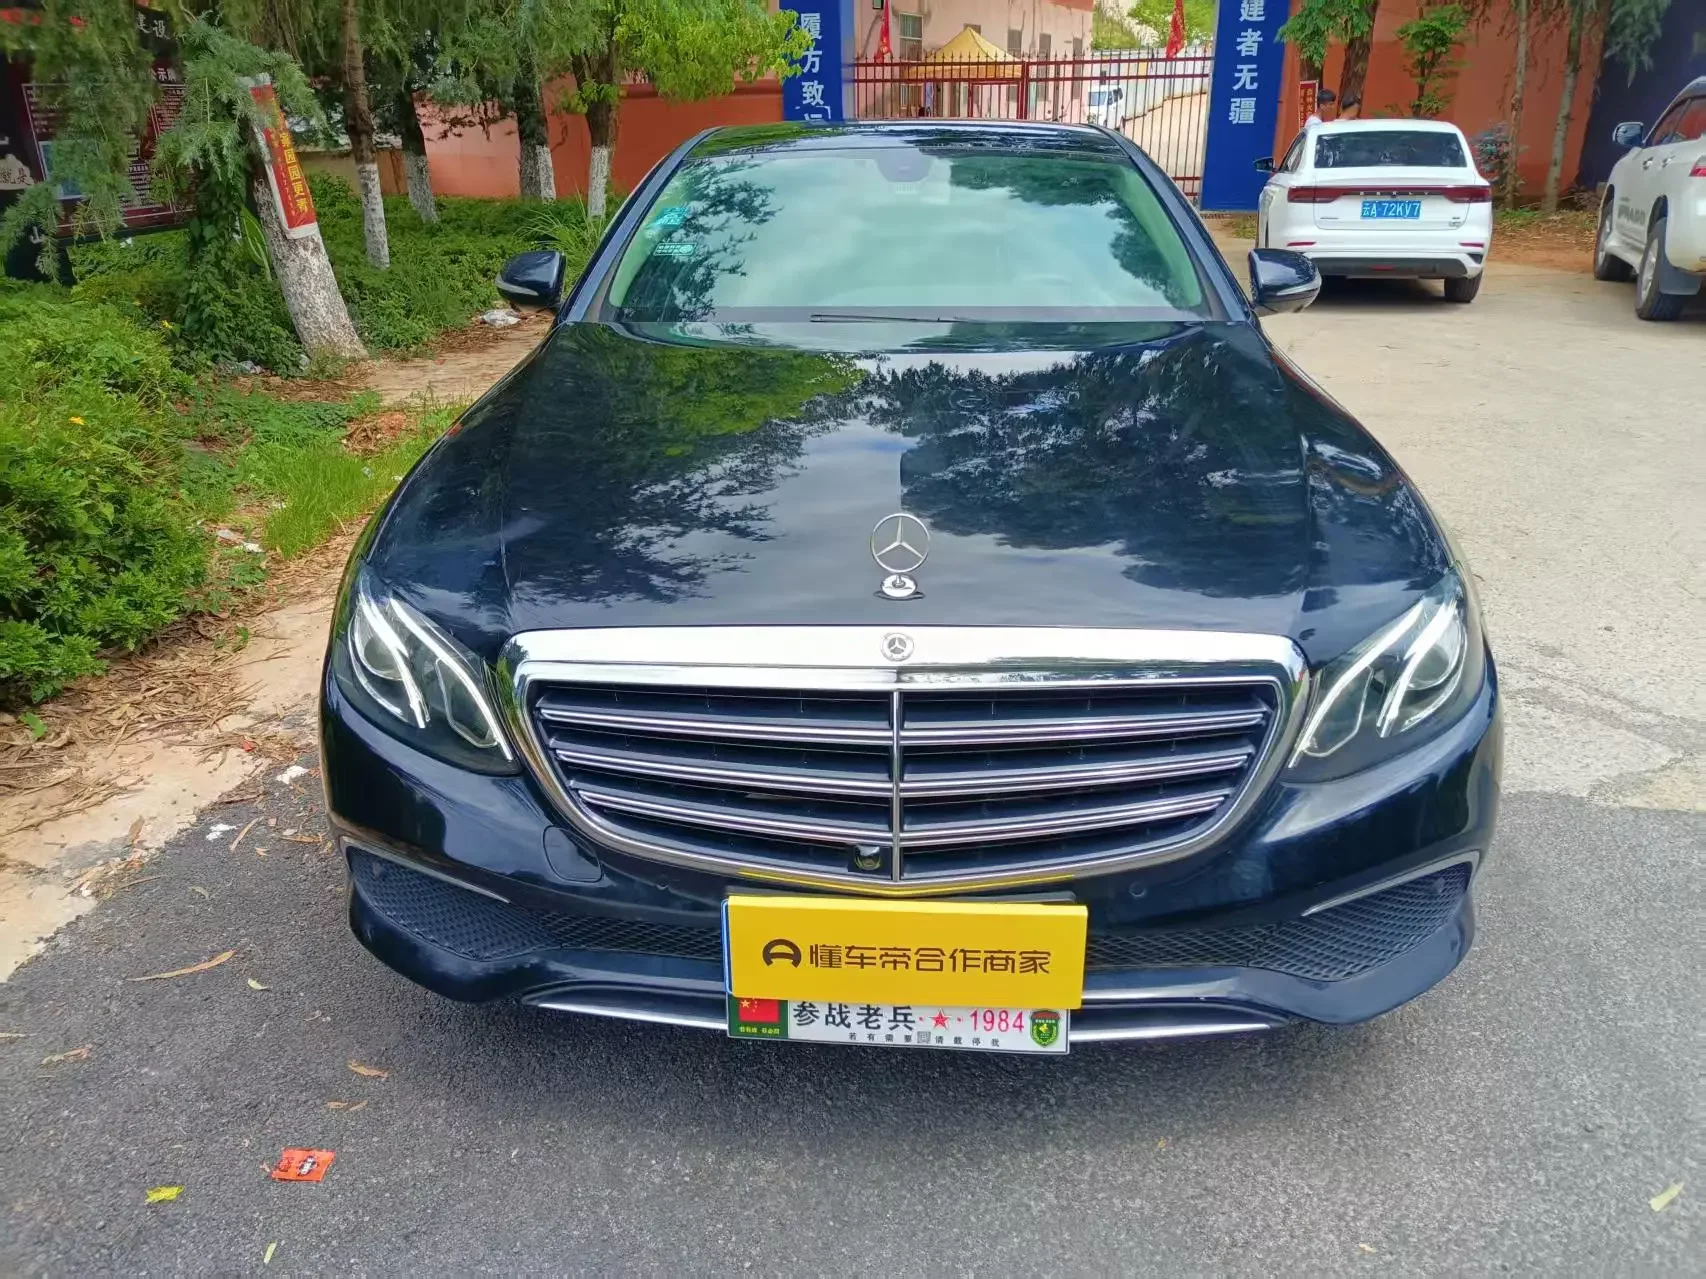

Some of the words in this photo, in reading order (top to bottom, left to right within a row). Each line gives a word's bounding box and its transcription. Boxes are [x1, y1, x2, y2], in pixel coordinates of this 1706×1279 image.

[1228, 0, 1266, 125] 建者无疆
[809, 943, 1051, 975] 懂车帝合作商家
[792, 1001, 916, 1032] 参战老兵
[970, 1008, 1025, 1033] 1984
